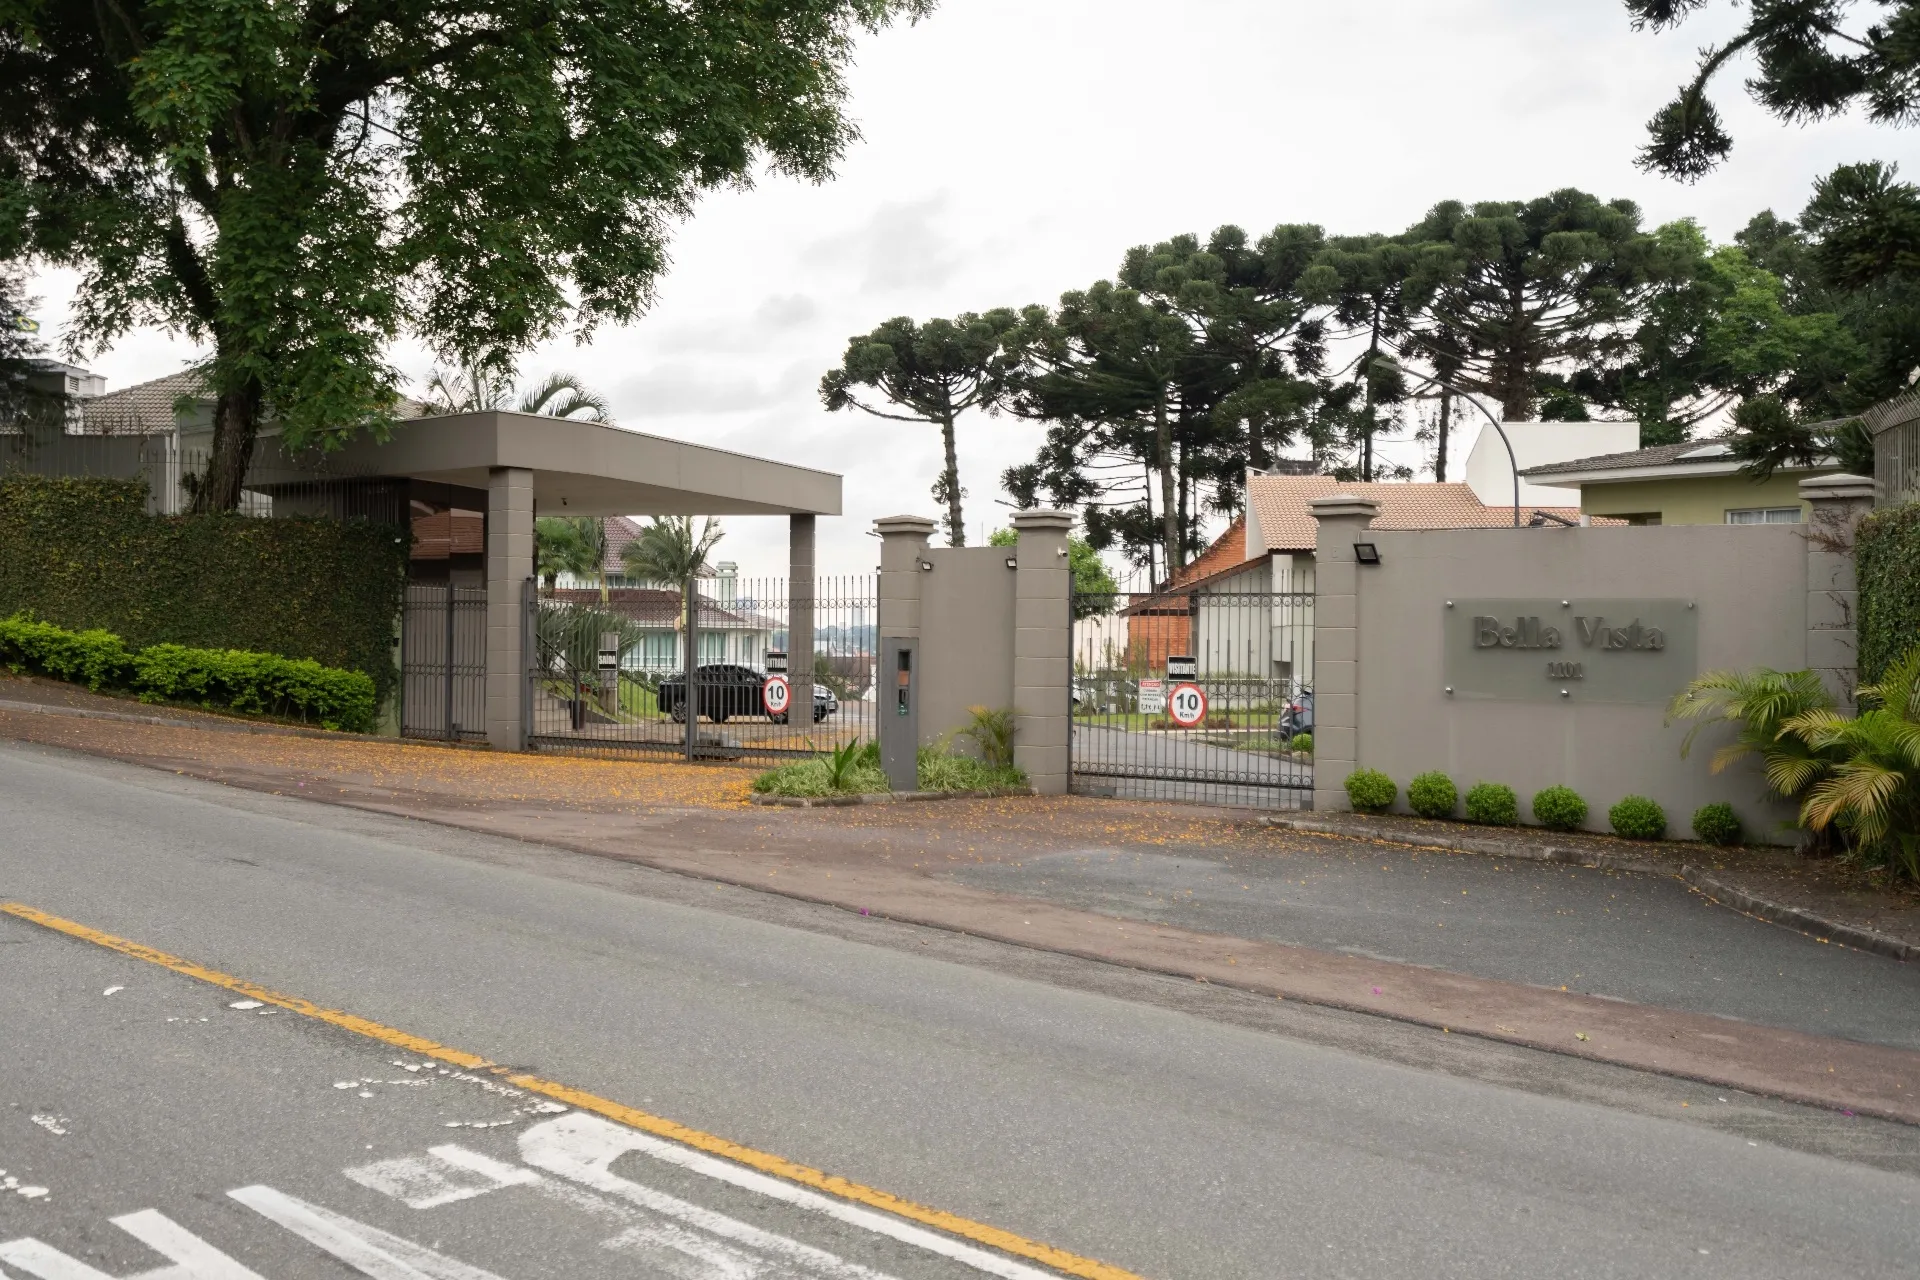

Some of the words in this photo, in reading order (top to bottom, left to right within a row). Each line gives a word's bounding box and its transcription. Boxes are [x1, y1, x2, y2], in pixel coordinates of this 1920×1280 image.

[1473, 615, 1561, 649] Bella
[1574, 616, 1665, 649] Vista
[1169, 662, 1196, 675] VISITANTE
[1546, 661, 1583, 678] 1101
[768, 685, 784, 700] 10
[1176, 693, 1199, 711] 10
